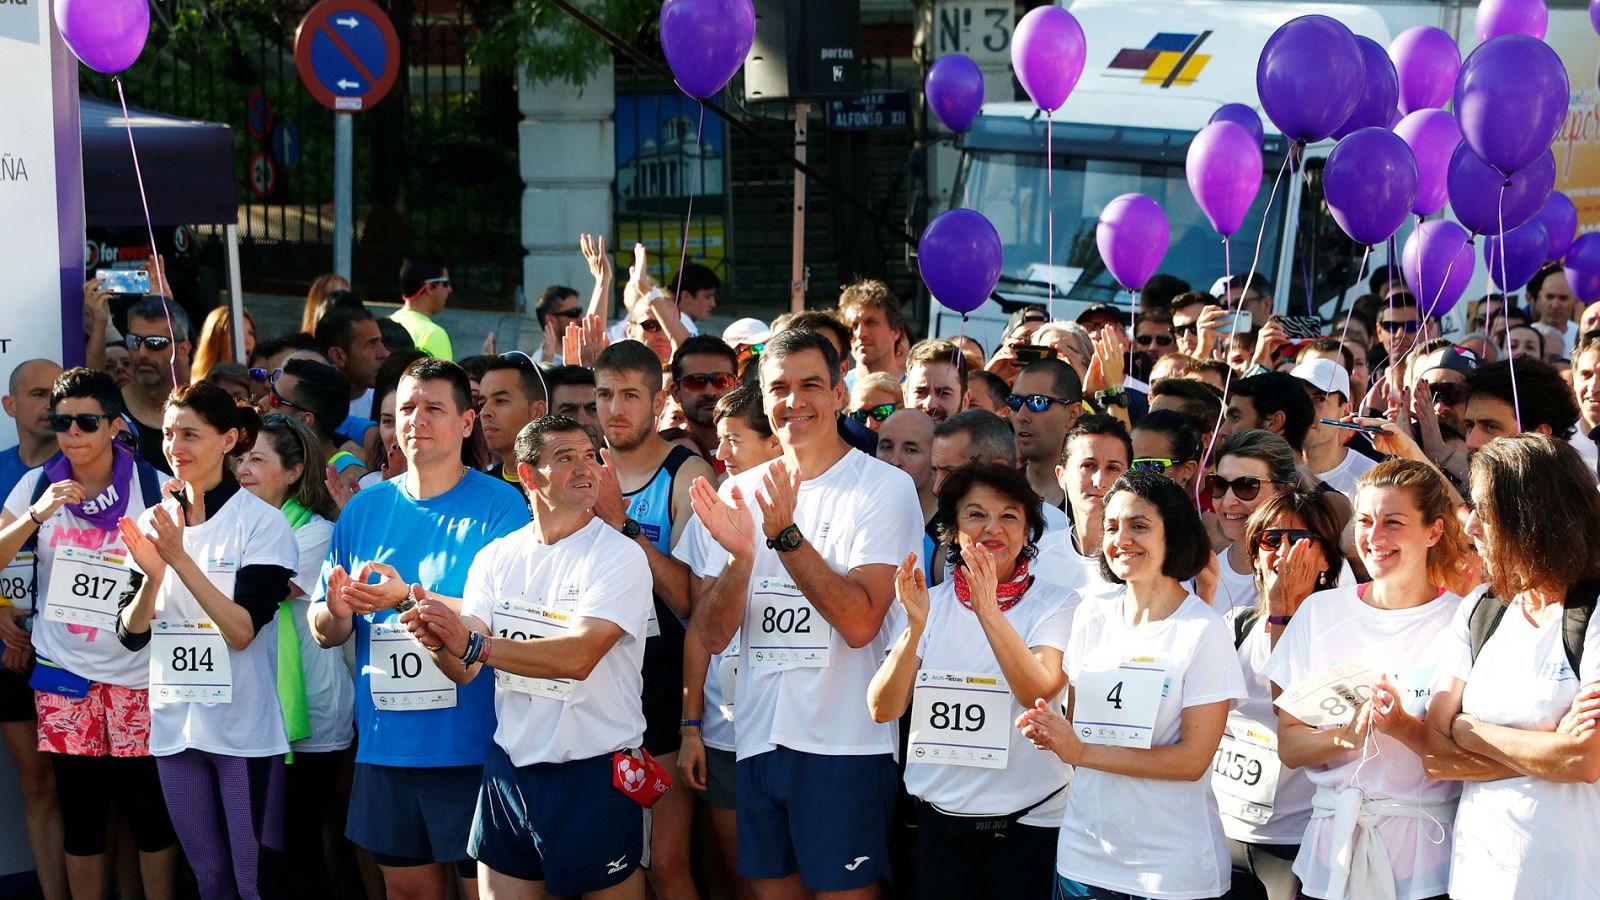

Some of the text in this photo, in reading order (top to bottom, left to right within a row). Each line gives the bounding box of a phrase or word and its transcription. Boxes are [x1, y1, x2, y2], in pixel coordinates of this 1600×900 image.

[983, 8, 1009, 52] 3
[836, 112, 906, 127] ALFONSO XII
[0, 152, 29, 181] ÑA
[83, 484, 119, 515] 8M
[72, 574, 117, 600] 817
[762, 606, 810, 633] 802
[172, 646, 214, 672] 814
[390, 652, 422, 679] 10
[1106, 681, 1124, 709] 4
[930, 702, 985, 732] 819
[1214, 747, 1262, 786] 1159
